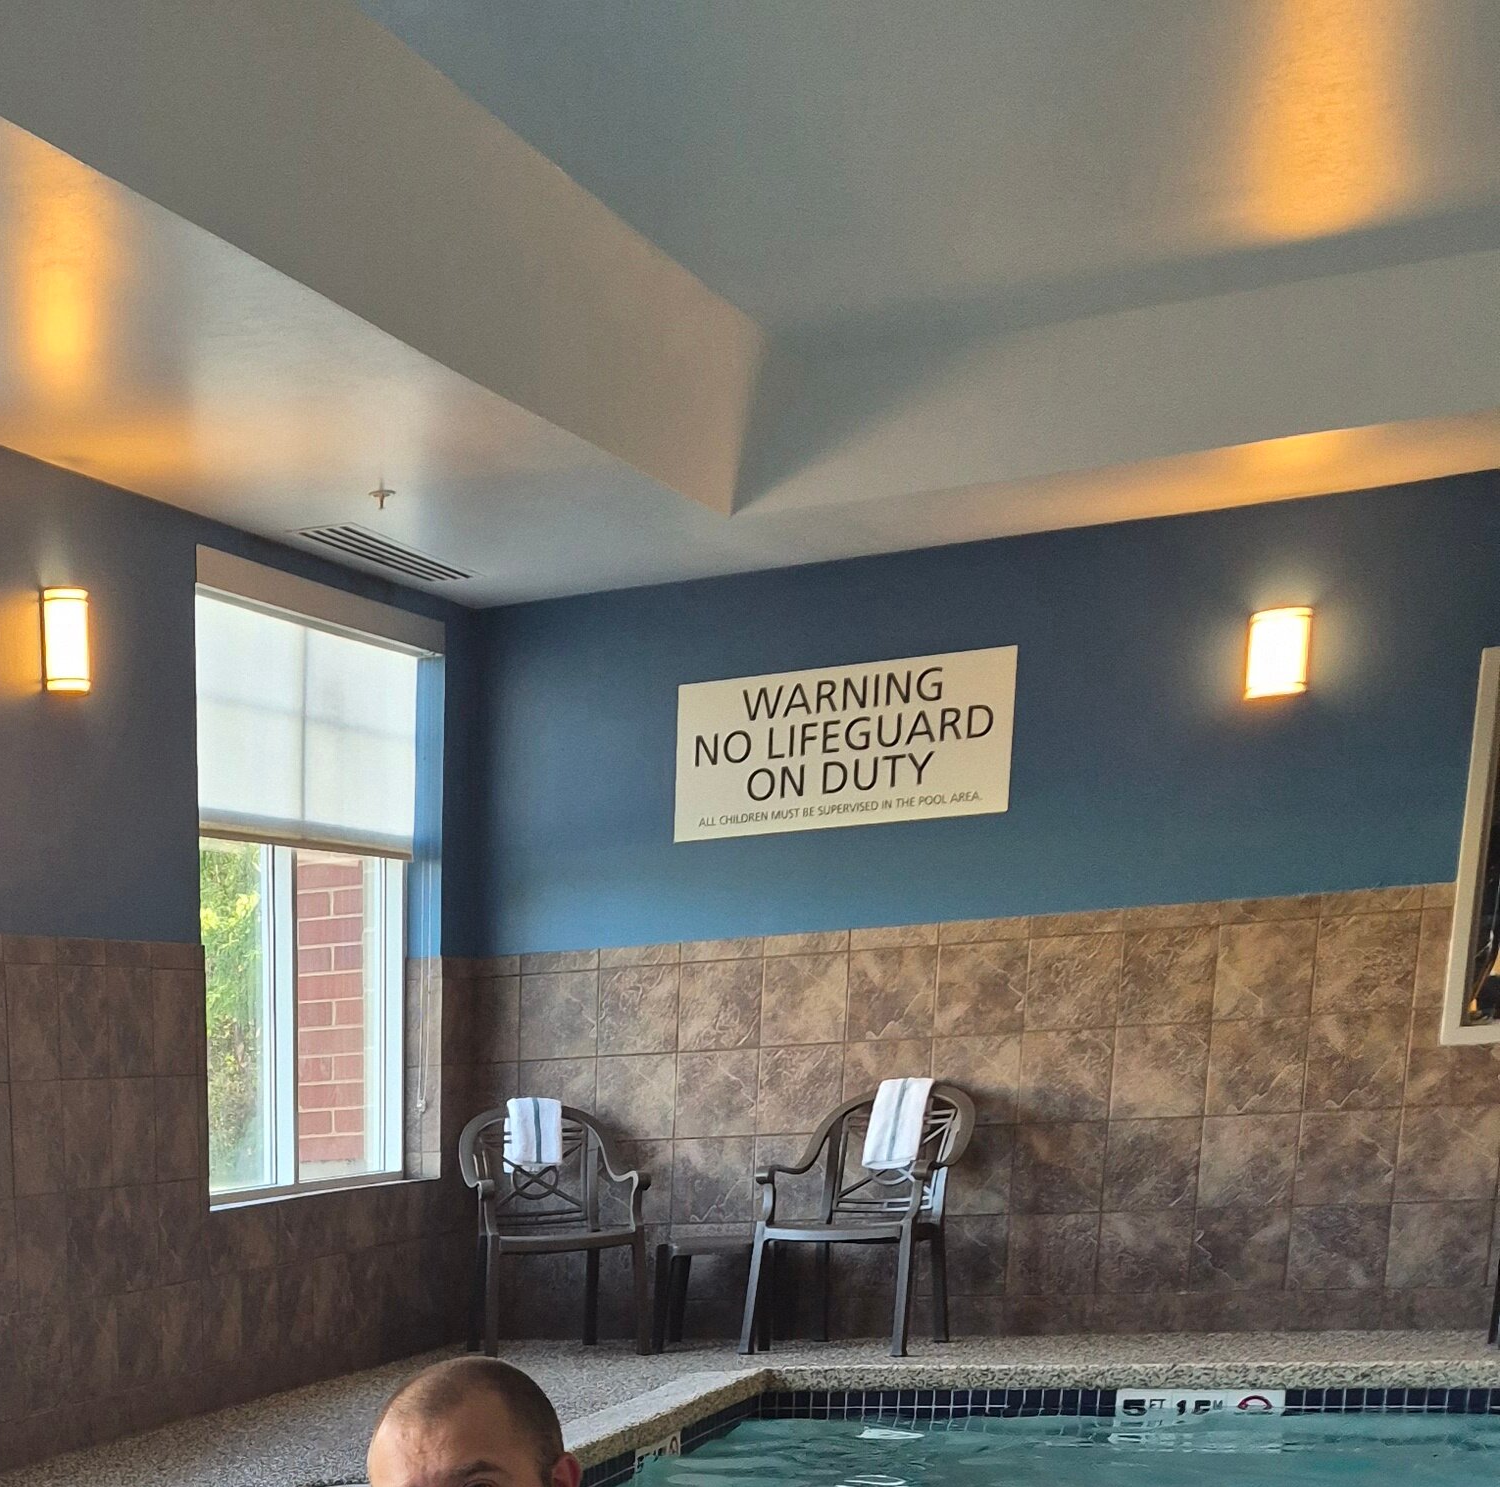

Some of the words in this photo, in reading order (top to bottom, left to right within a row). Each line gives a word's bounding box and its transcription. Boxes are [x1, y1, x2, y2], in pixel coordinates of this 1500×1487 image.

[743, 666, 943, 721] WARNING
[694, 730, 752, 767] NO
[767, 704, 994, 759] LIFEGUARD
[746, 764, 805, 801] ON
[821, 751, 935, 794] DUTY
[698, 817, 716, 827] ALL
[719, 811, 768, 825] CHILDREN
[771, 808, 800, 820] MUST
[803, 806, 815, 817] BE
[818, 800, 879, 816] SUPERVISED
[881, 799, 893, 809] IN
[896, 796, 916, 808] THE
[918, 794, 948, 806] POOL
